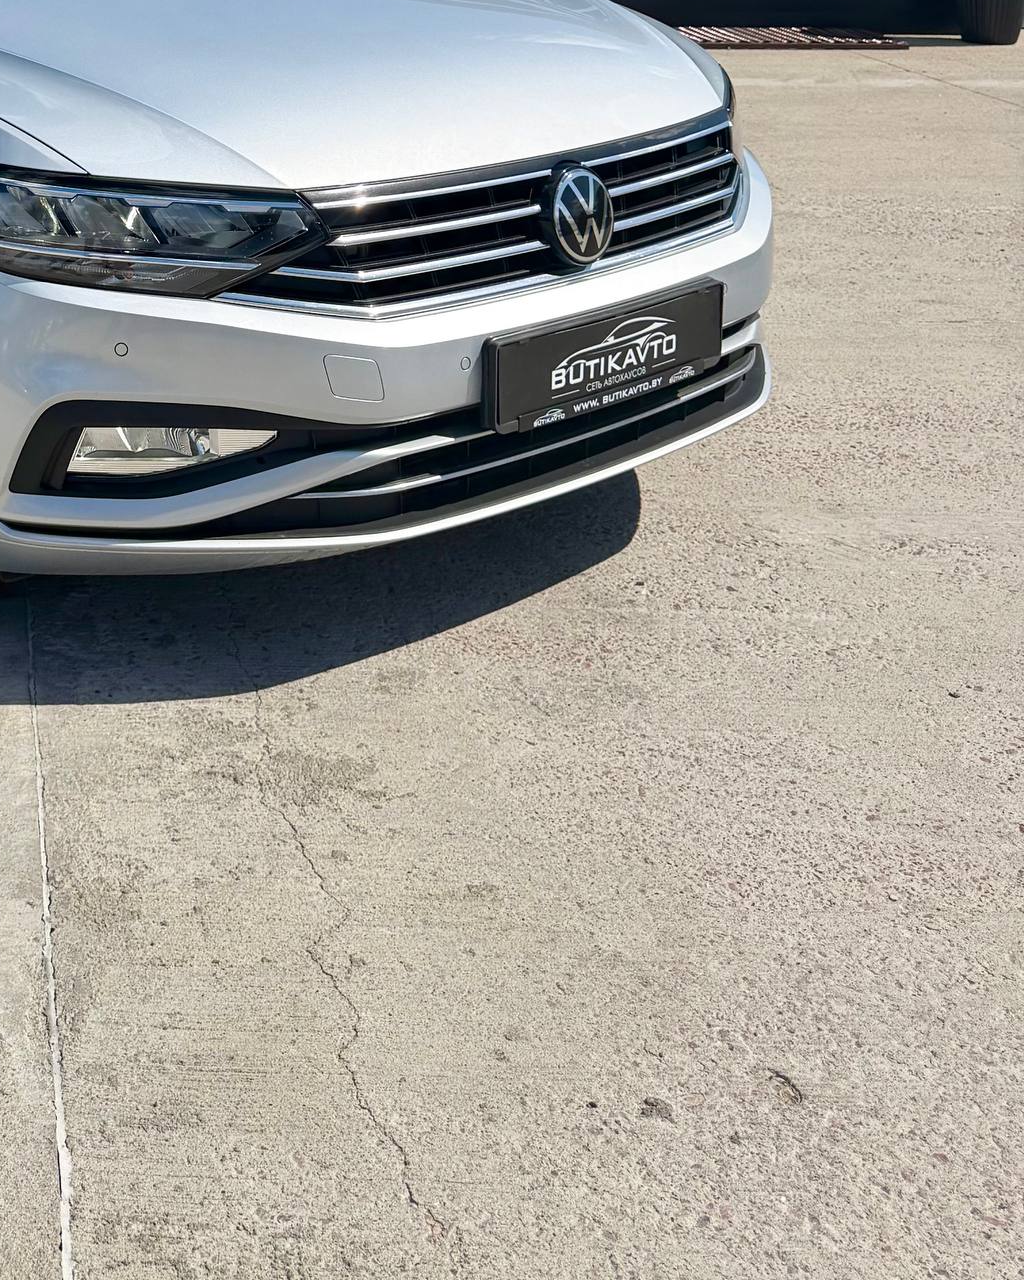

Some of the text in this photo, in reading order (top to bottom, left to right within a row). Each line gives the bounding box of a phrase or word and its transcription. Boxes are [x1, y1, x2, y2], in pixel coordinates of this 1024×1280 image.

[551, 333, 677, 390] BUTIKAVTO
[586, 365, 647, 392] СЕТЬ АВТОХАУСОВ
[573, 376, 663, 413] WWW. BUTIKAVTO.BY
